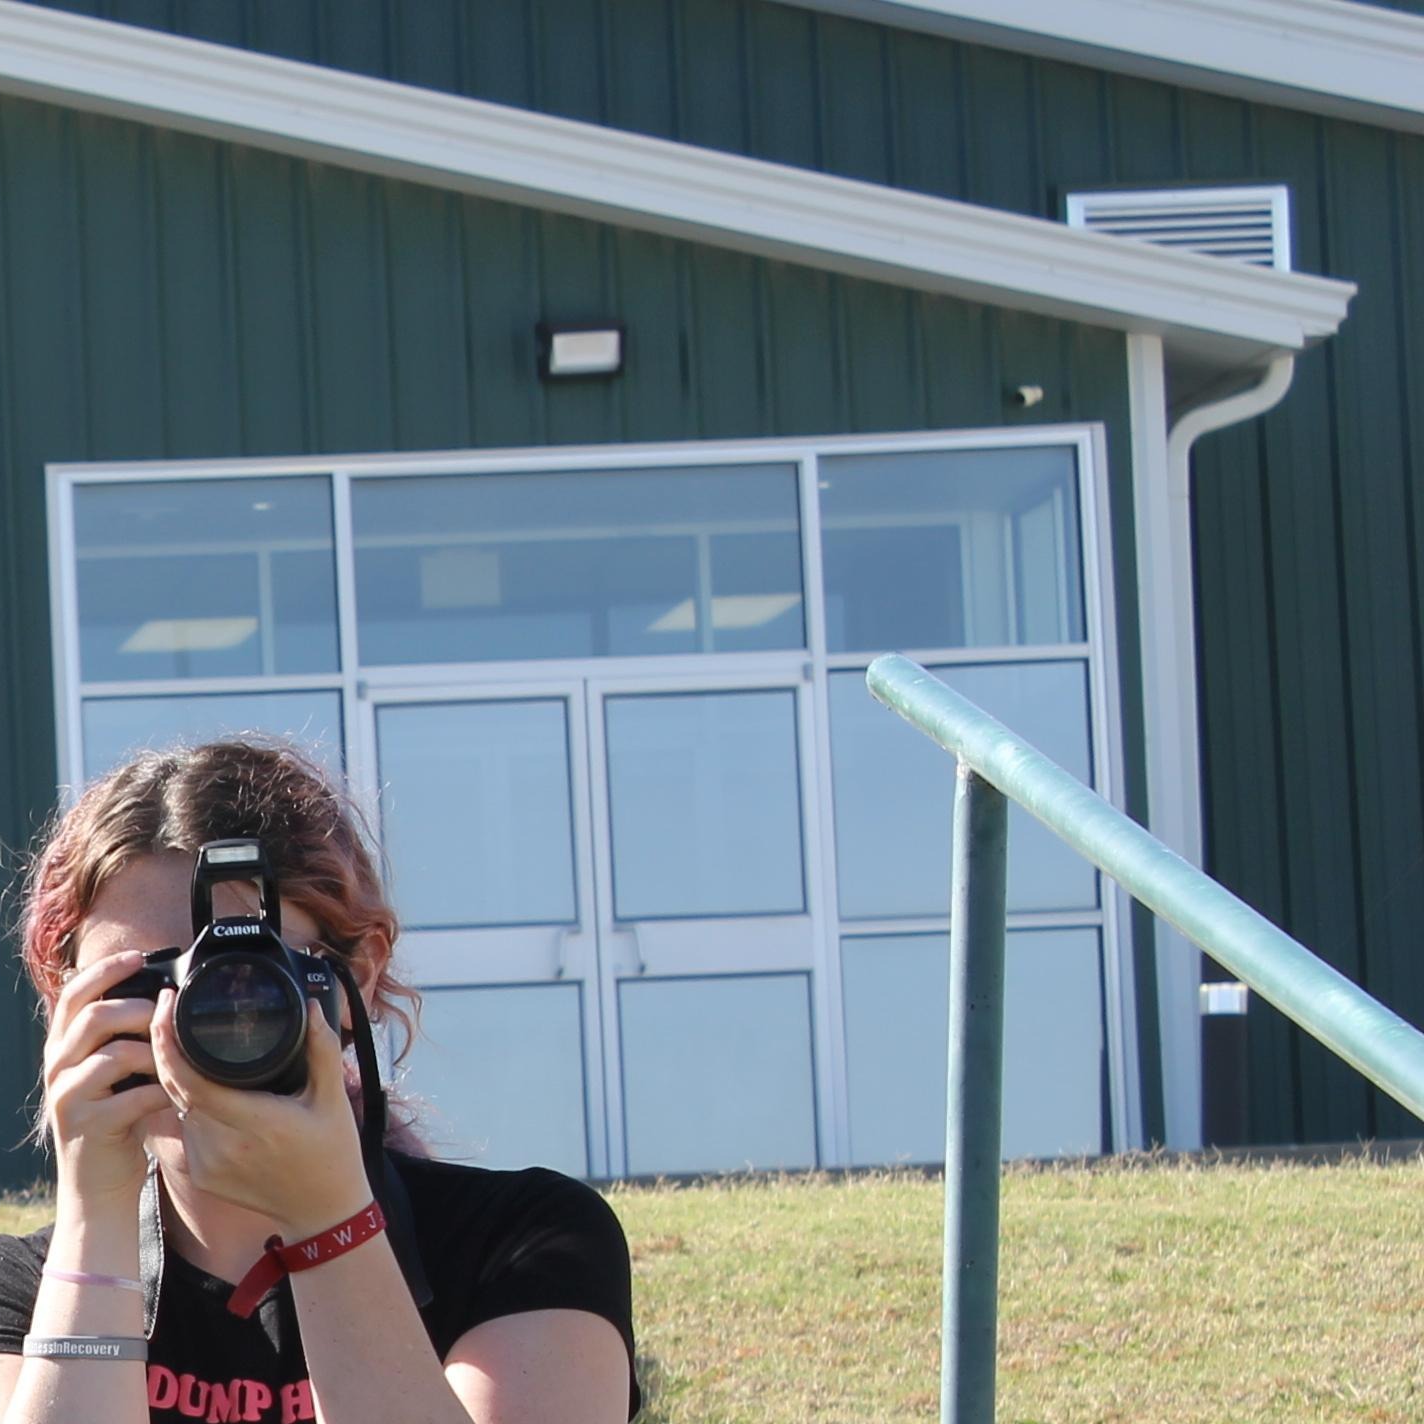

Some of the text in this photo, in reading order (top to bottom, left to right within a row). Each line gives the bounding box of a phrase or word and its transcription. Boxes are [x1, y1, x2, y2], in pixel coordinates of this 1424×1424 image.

[213, 924, 260, 937] Canon
[306, 972, 326, 982] EOS
[148, 1364, 272, 1424] DUMP
